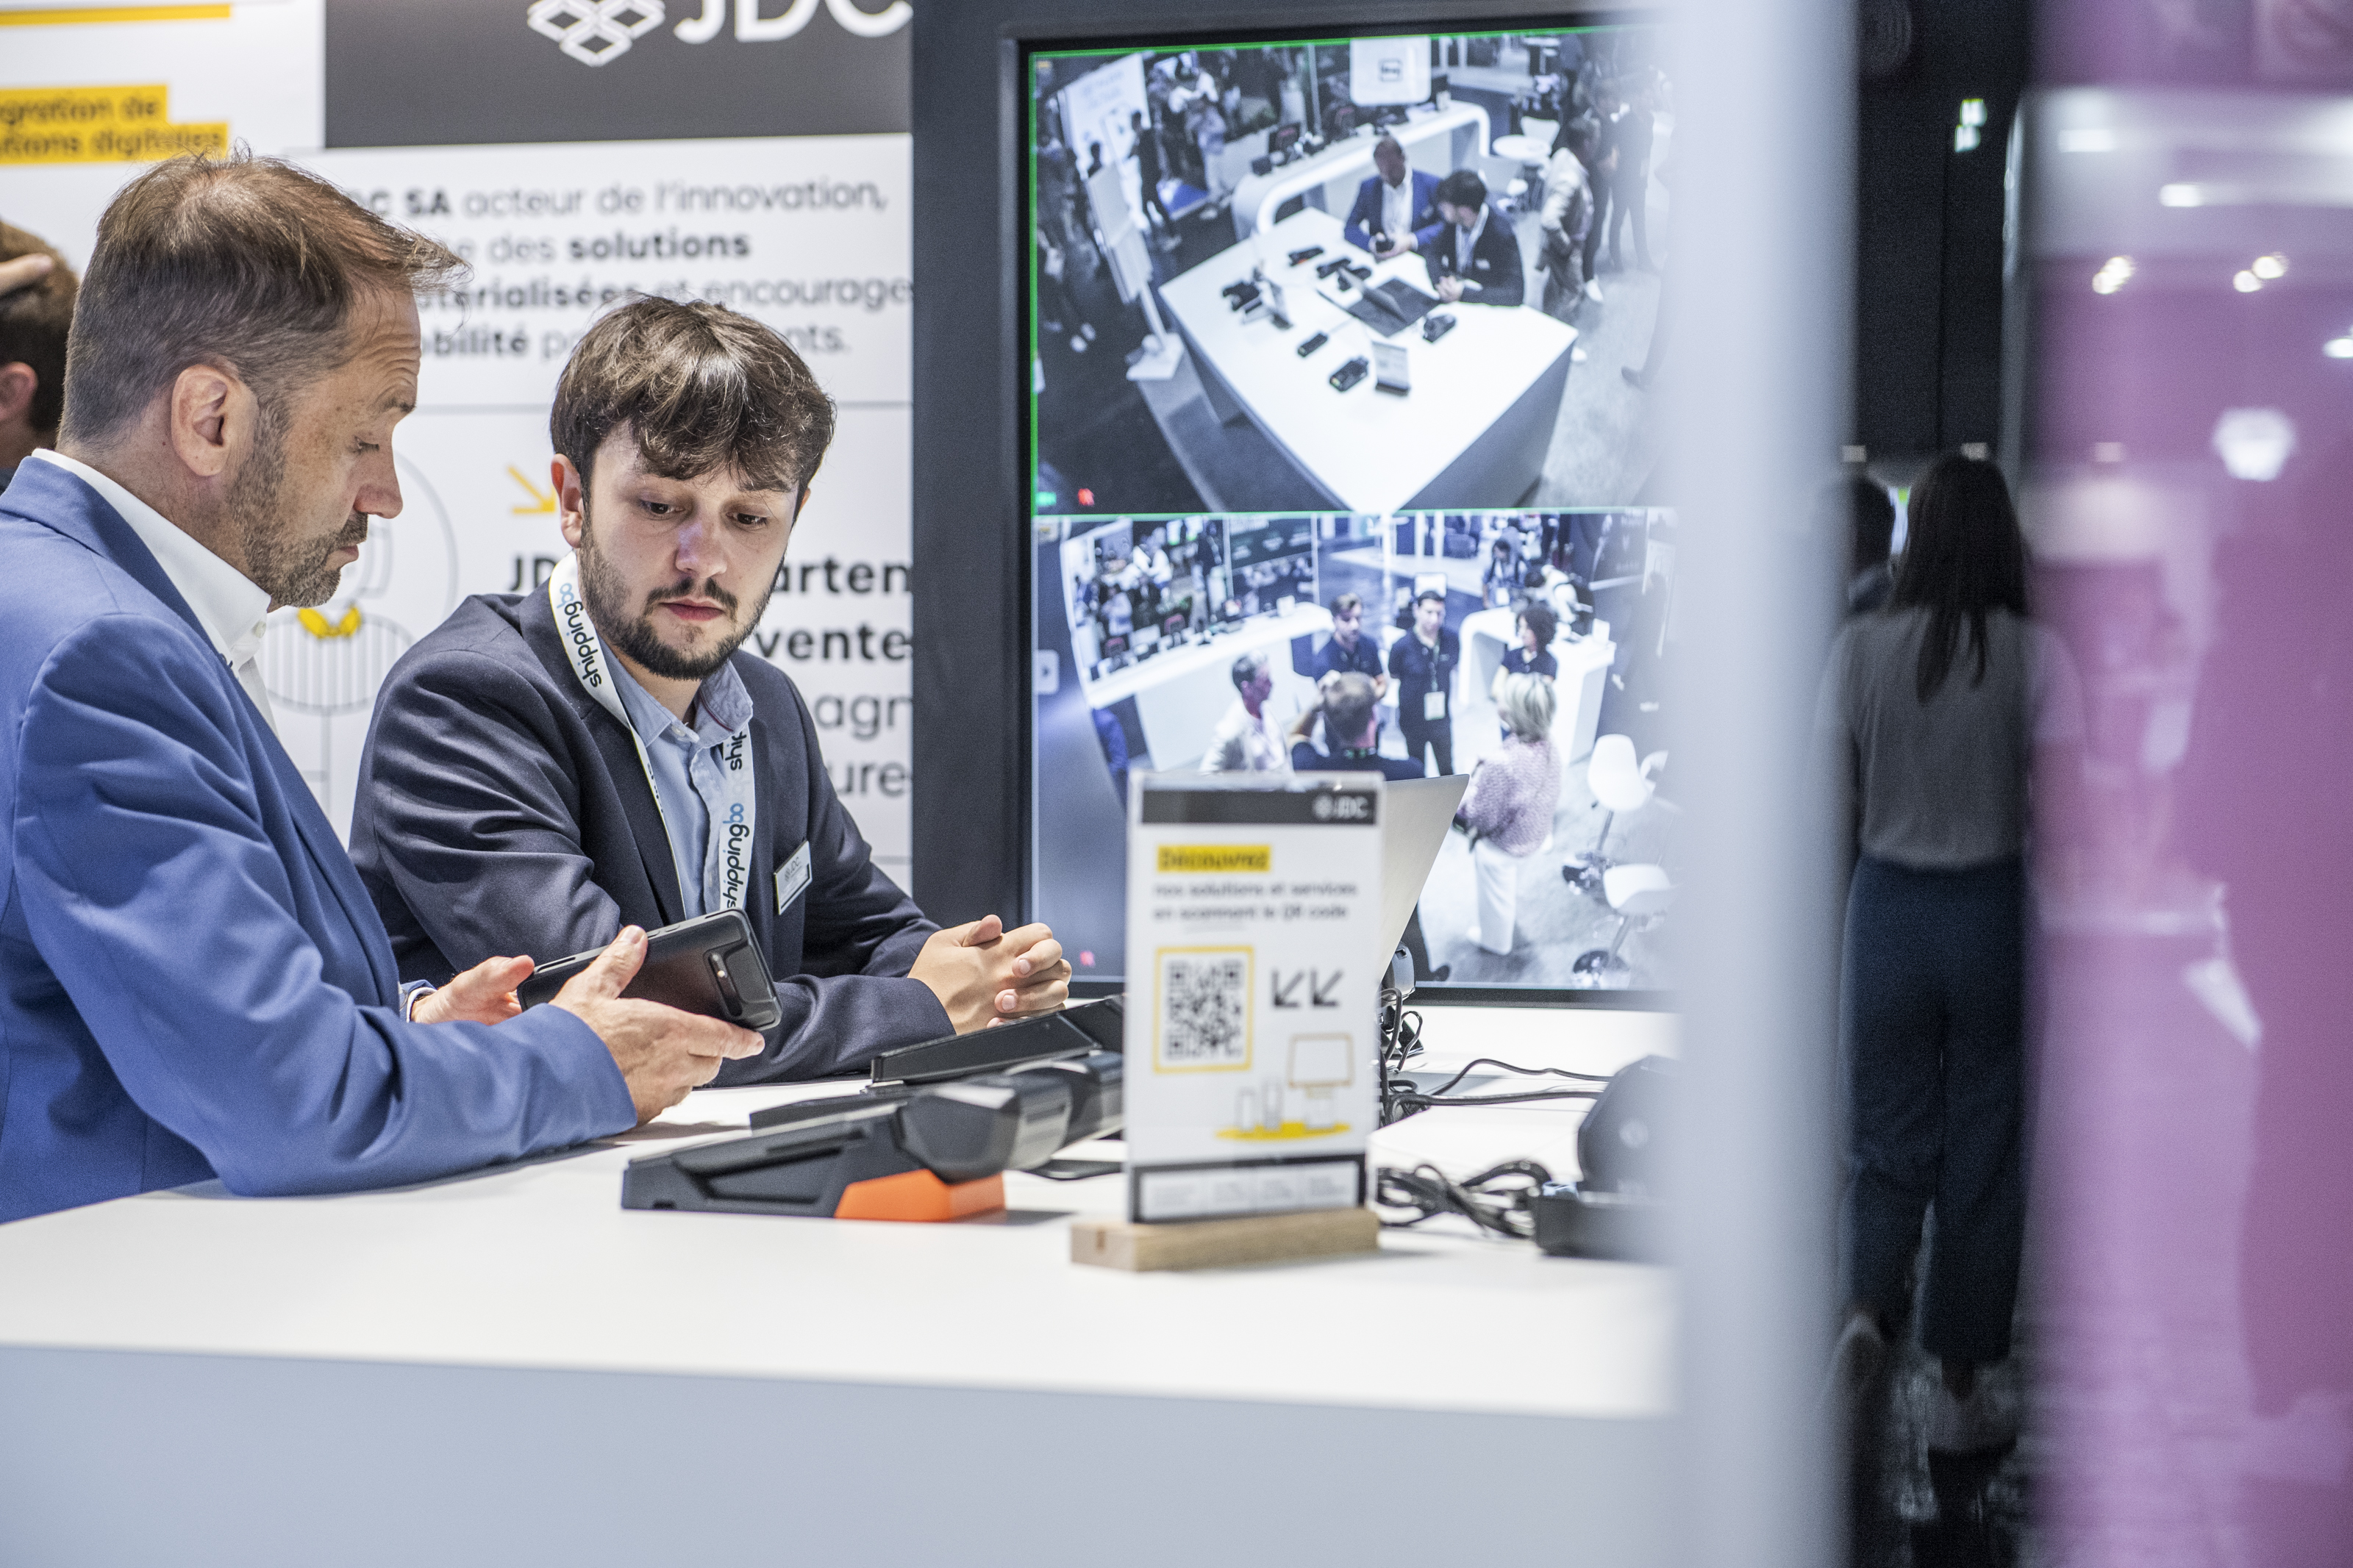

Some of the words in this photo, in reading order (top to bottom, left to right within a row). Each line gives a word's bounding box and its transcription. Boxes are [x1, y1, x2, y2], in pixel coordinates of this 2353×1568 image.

[0, 90, 111, 126] gration
[1, 129, 83, 157] tions
[405, 189, 450, 215] SA
[463, 187, 582, 217] acteur
[596, 181, 646, 215] de
[656, 176, 889, 213] l'innovation,
[488, 230, 555, 264] des
[567, 225, 751, 263] solutions
[510, 556, 557, 592] JD
[825, 760, 909, 798] ure
